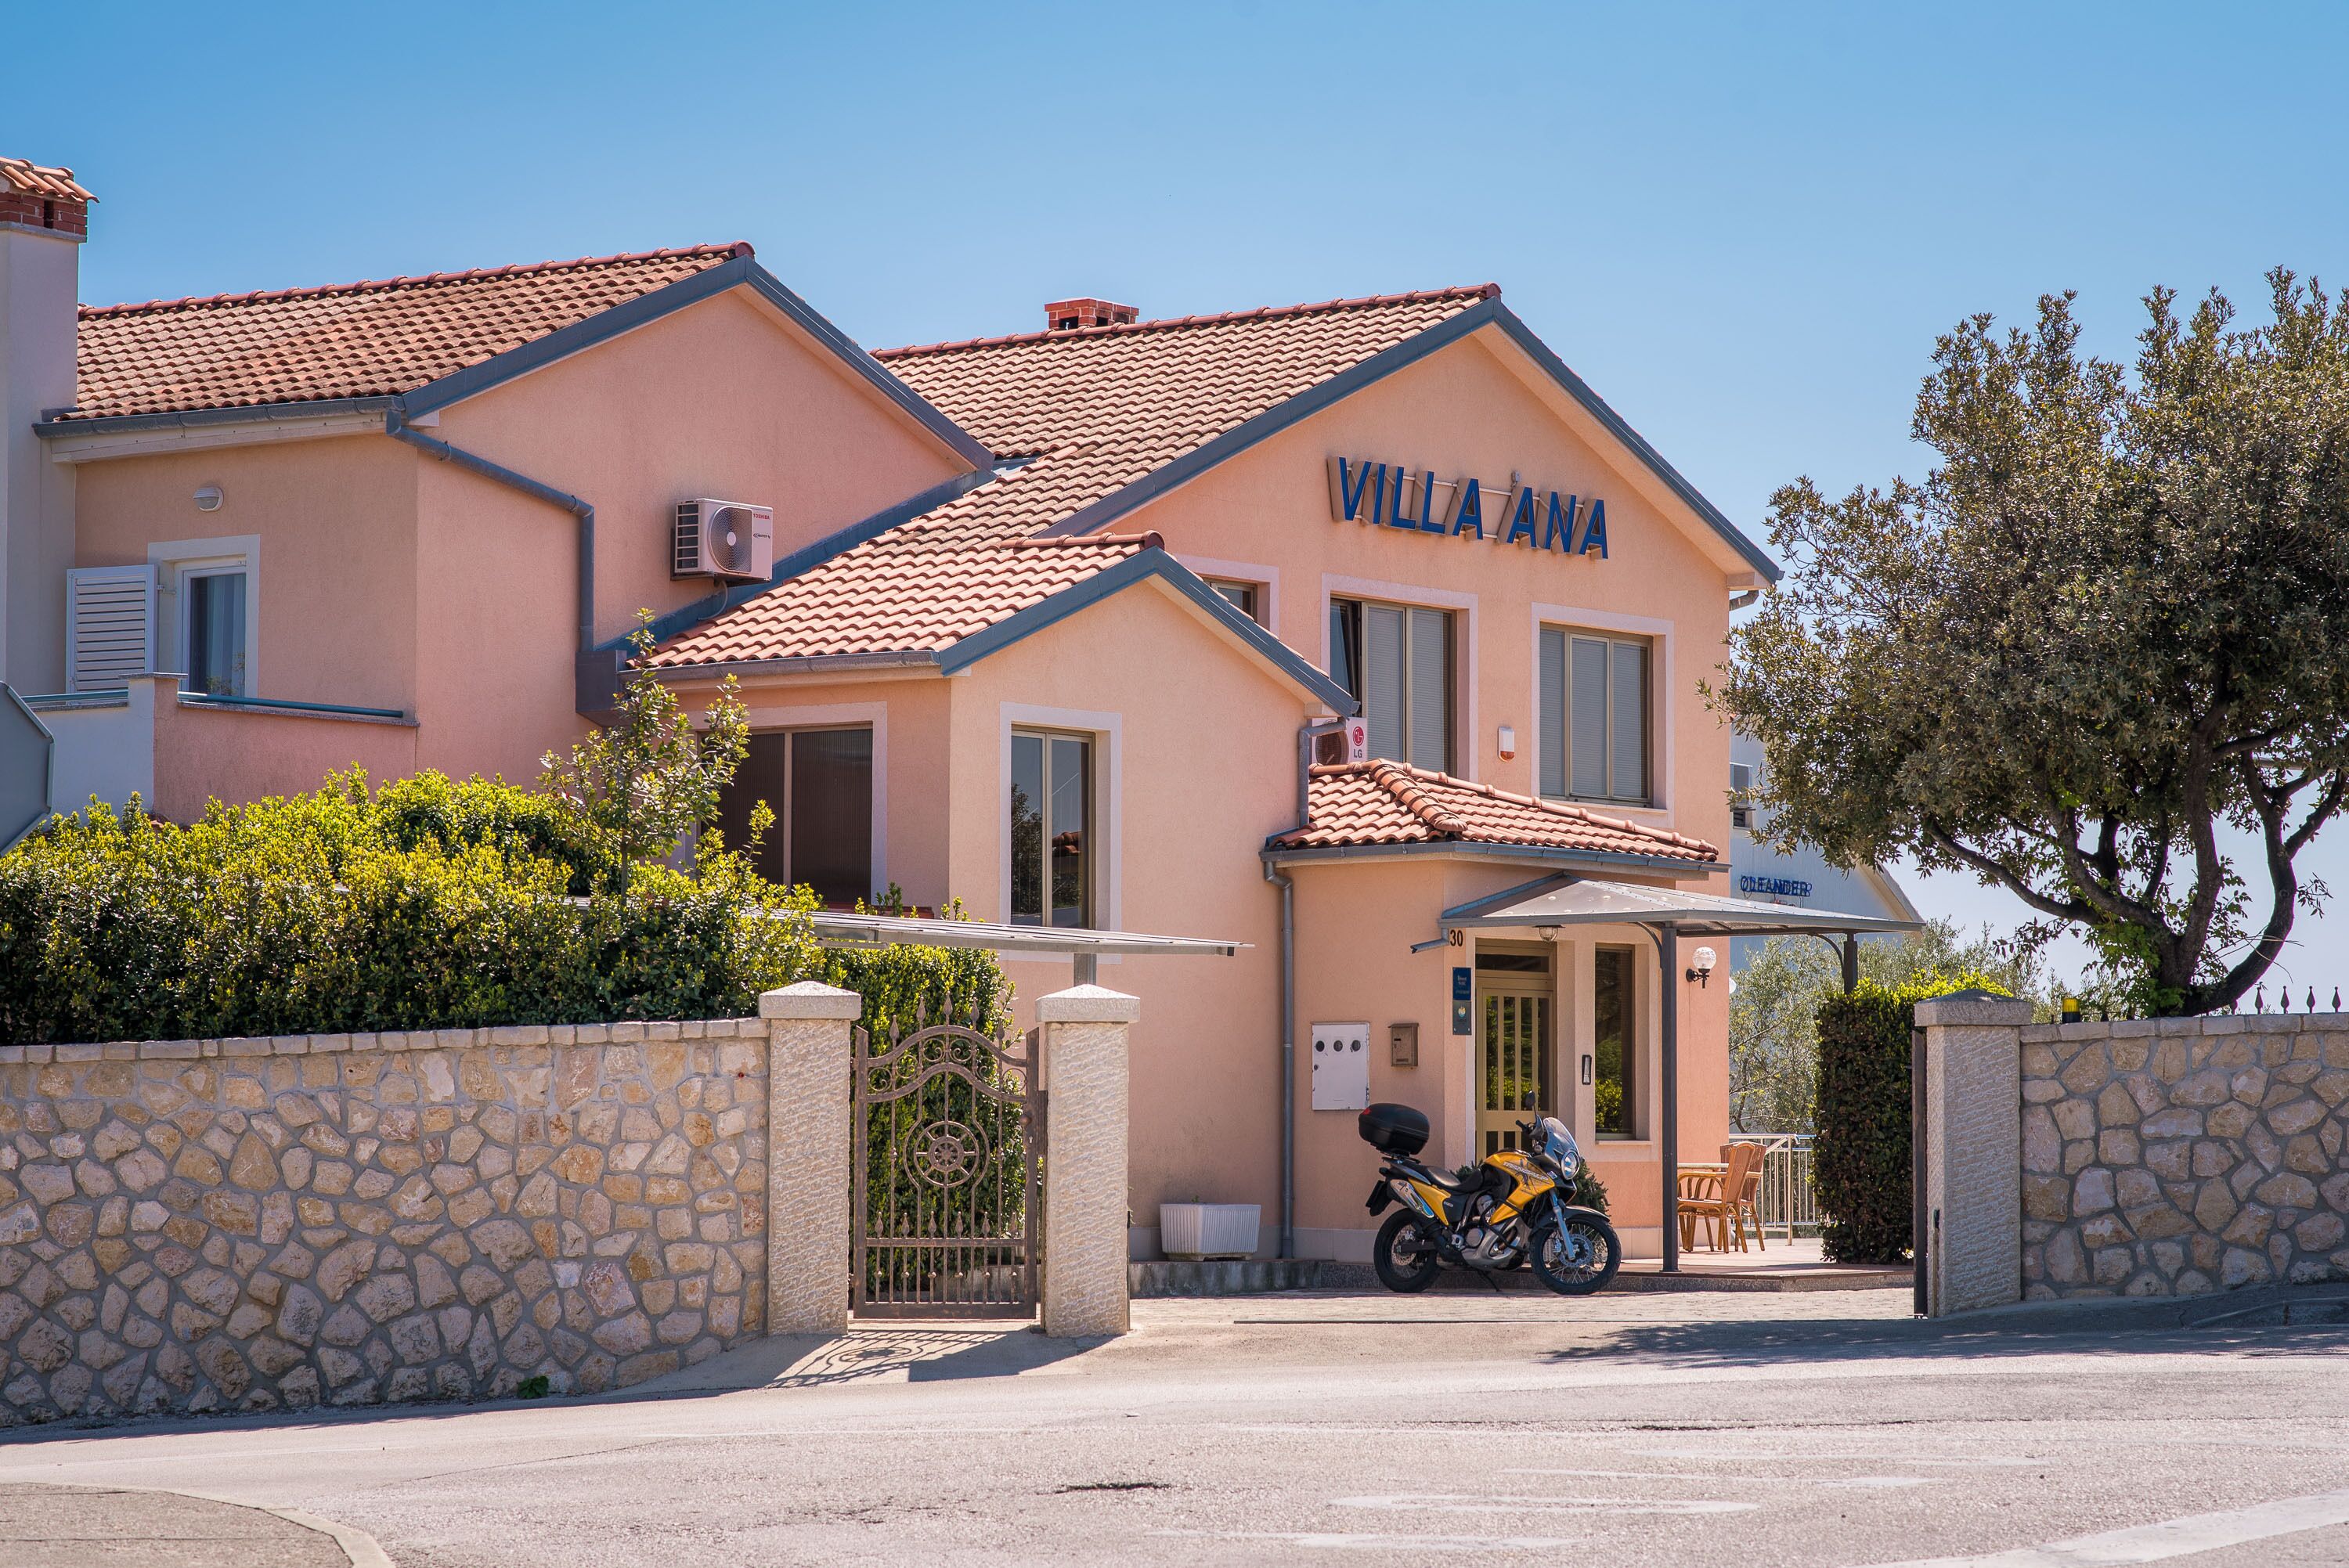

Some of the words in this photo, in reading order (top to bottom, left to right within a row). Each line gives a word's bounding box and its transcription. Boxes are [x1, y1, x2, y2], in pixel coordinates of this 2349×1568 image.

[1336, 456, 1483, 540] VILLA
[1505, 486, 1608, 560] ANA
[1353, 749, 1362, 758] LG
[1740, 875, 1813, 897] OLEANDER
[1450, 929, 1463, 947] 30
